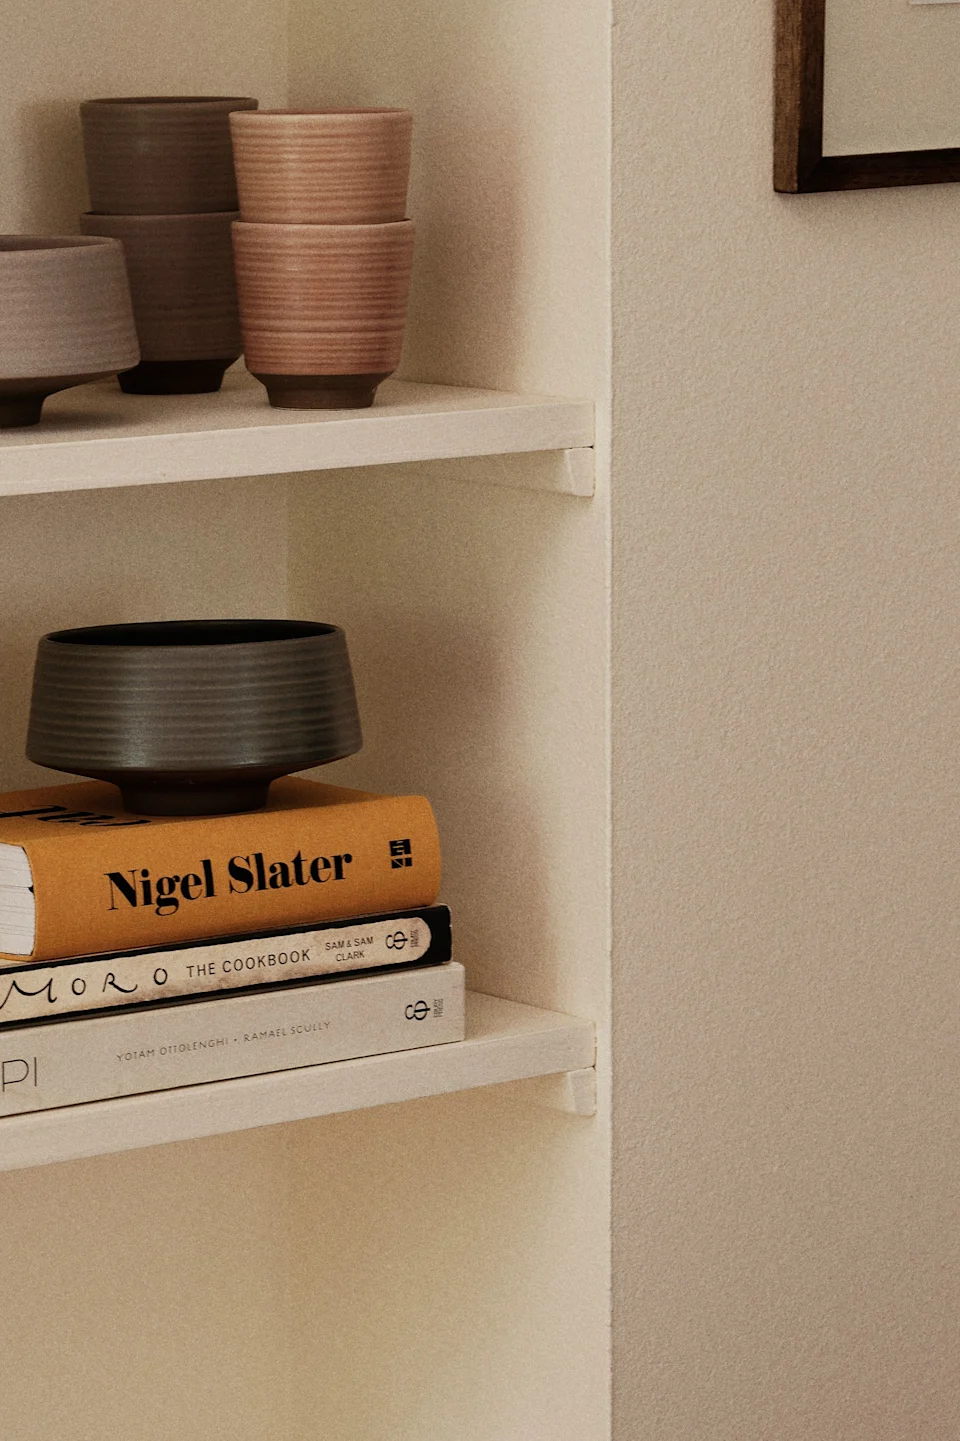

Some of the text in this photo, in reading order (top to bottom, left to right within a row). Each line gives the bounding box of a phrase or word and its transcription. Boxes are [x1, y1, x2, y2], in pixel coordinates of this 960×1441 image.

[104, 850, 352, 916] Nigel Slater
[325, 936, 373, 951] SAM & SAM
[336, 950, 365, 962] CLARK
[186, 962, 215, 978] THE
[222, 949, 311, 973] COOKBOOK
[117, 1021, 330, 1061] YOTAM OTTOLENGHI RAMAEL SCULLY
